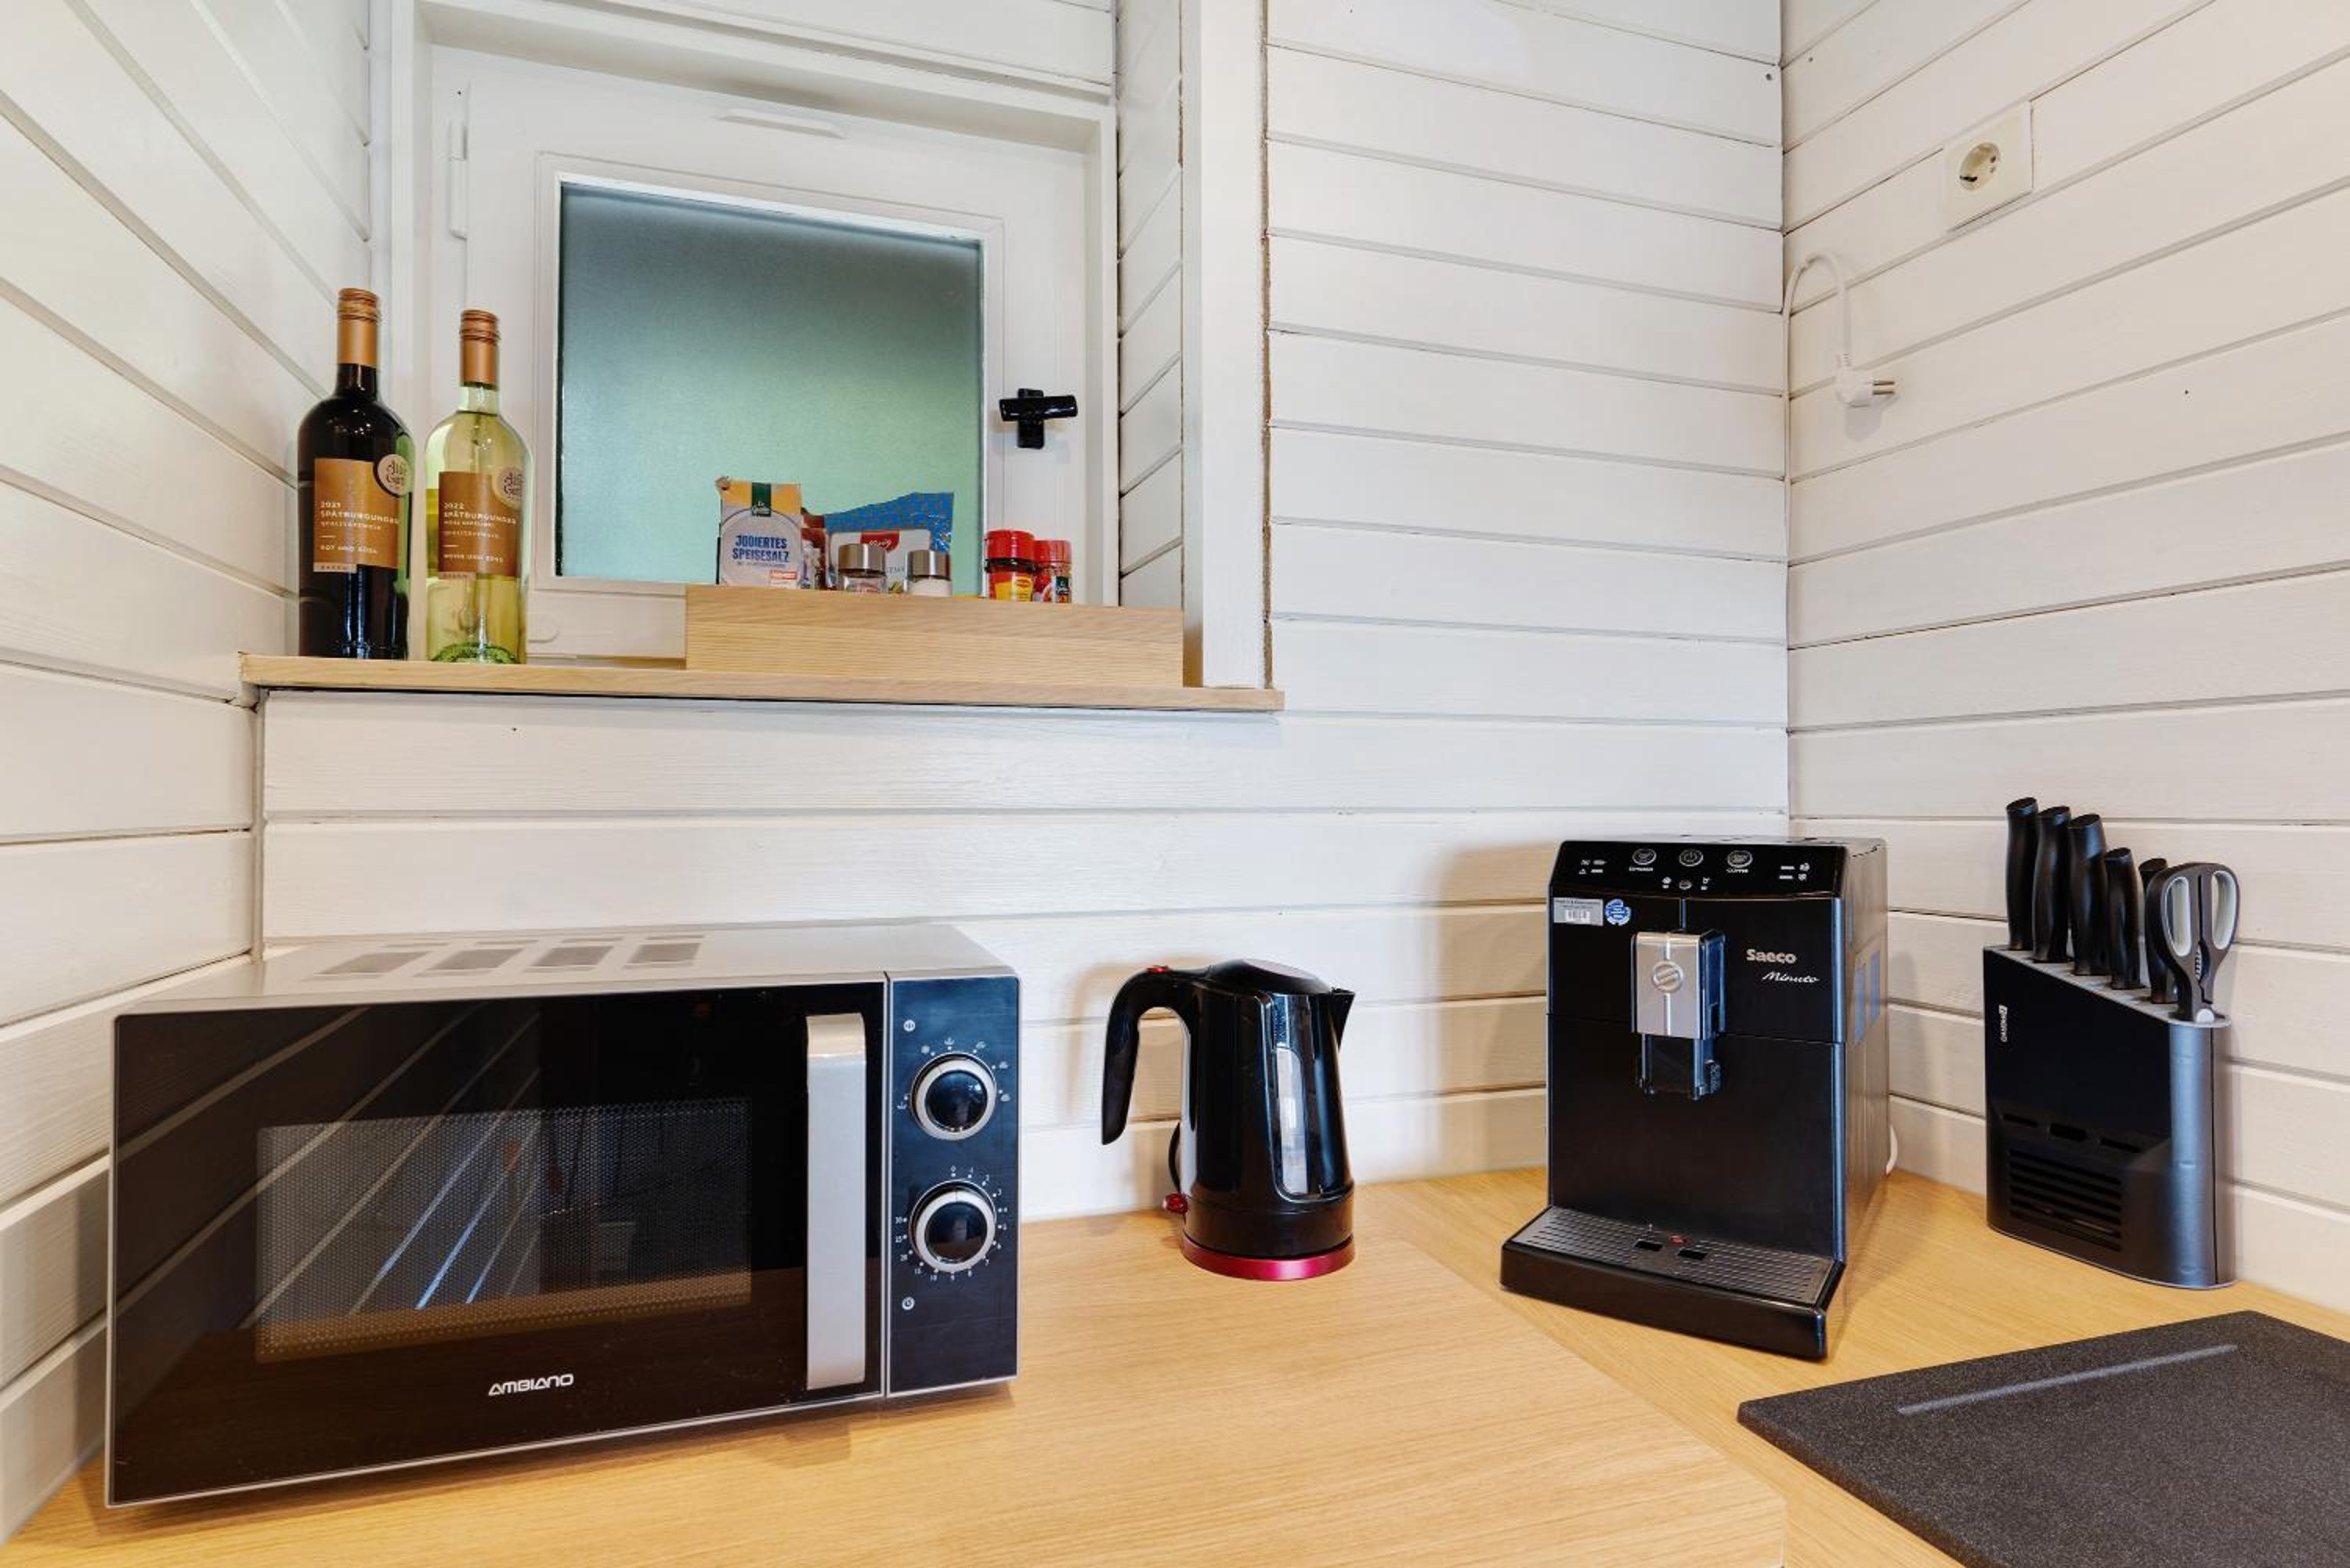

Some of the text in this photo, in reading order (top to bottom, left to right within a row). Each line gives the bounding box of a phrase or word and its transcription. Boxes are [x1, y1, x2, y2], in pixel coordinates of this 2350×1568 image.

[735, 535, 788, 549] JODIERTES
[732, 547, 790, 563] SPEISESALZ
[1746, 948, 1798, 964] Saeco
[1761, 971, 1820, 983] Minuto
[488, 1373, 574, 1396] AMBIANO
